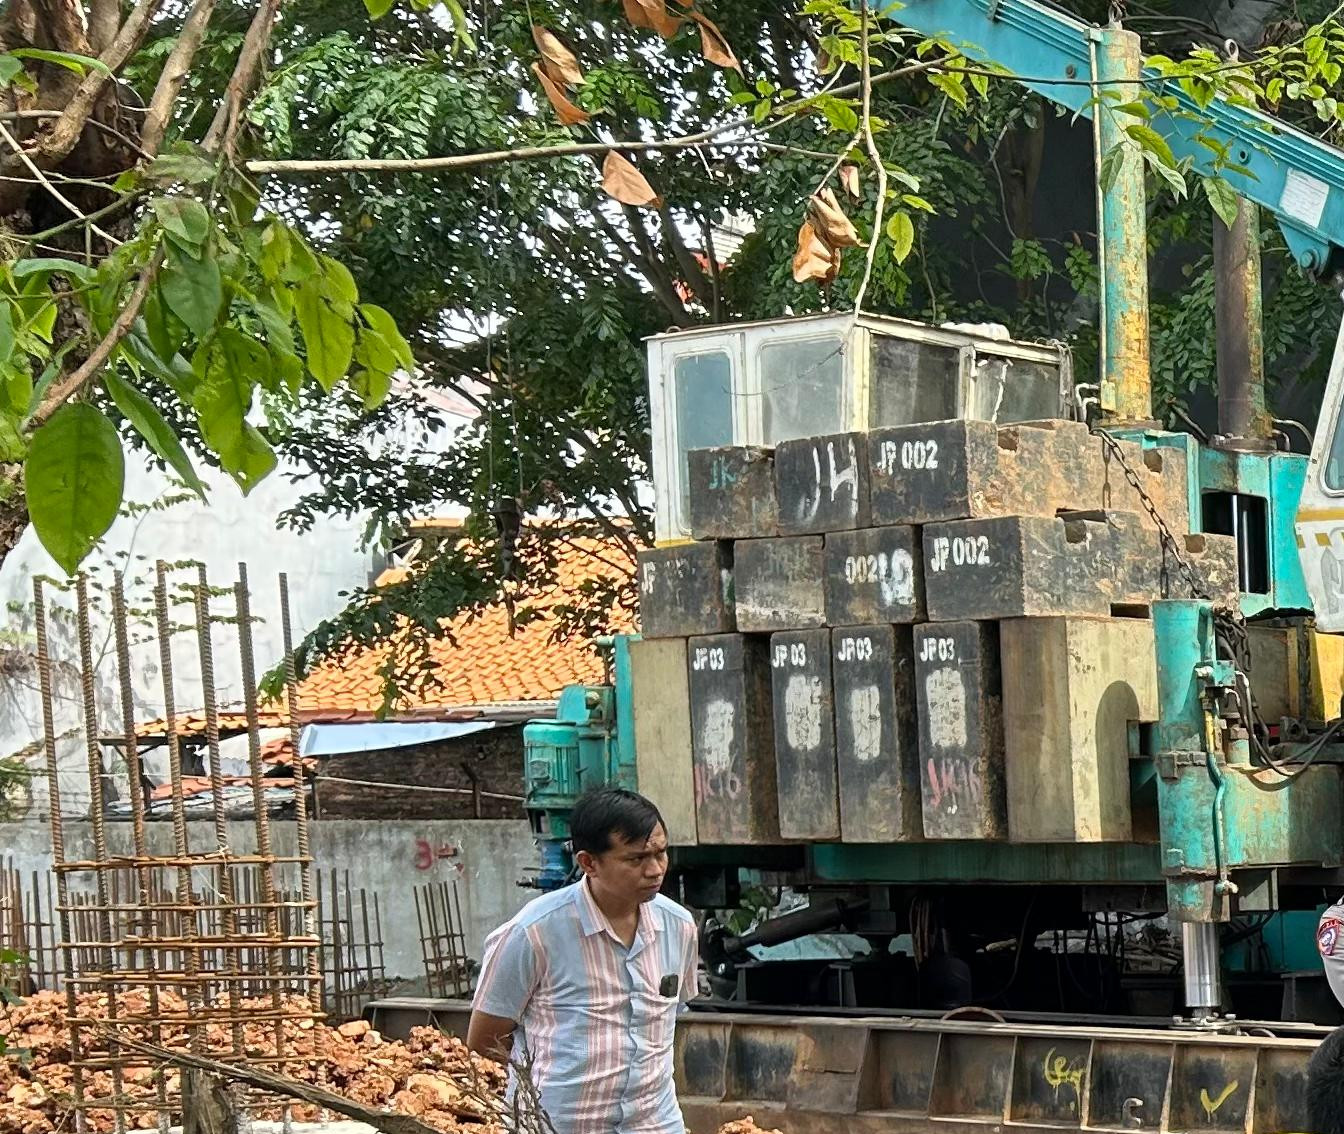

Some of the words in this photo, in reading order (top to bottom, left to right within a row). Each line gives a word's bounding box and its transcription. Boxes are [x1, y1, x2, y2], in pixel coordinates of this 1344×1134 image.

[877, 441, 896, 475] JP
[902, 440, 938, 470] 002
[931, 537, 949, 571] JP
[952, 536, 989, 568] 002
[693, 648, 707, 670] JP
[709, 648, 725, 670] 03
[772, 645, 787, 668] JP
[790, 643, 806, 667] 03
[856, 637, 872, 660] 03
[920, 638, 937, 661] JP
[938, 638, 955, 660] 03
